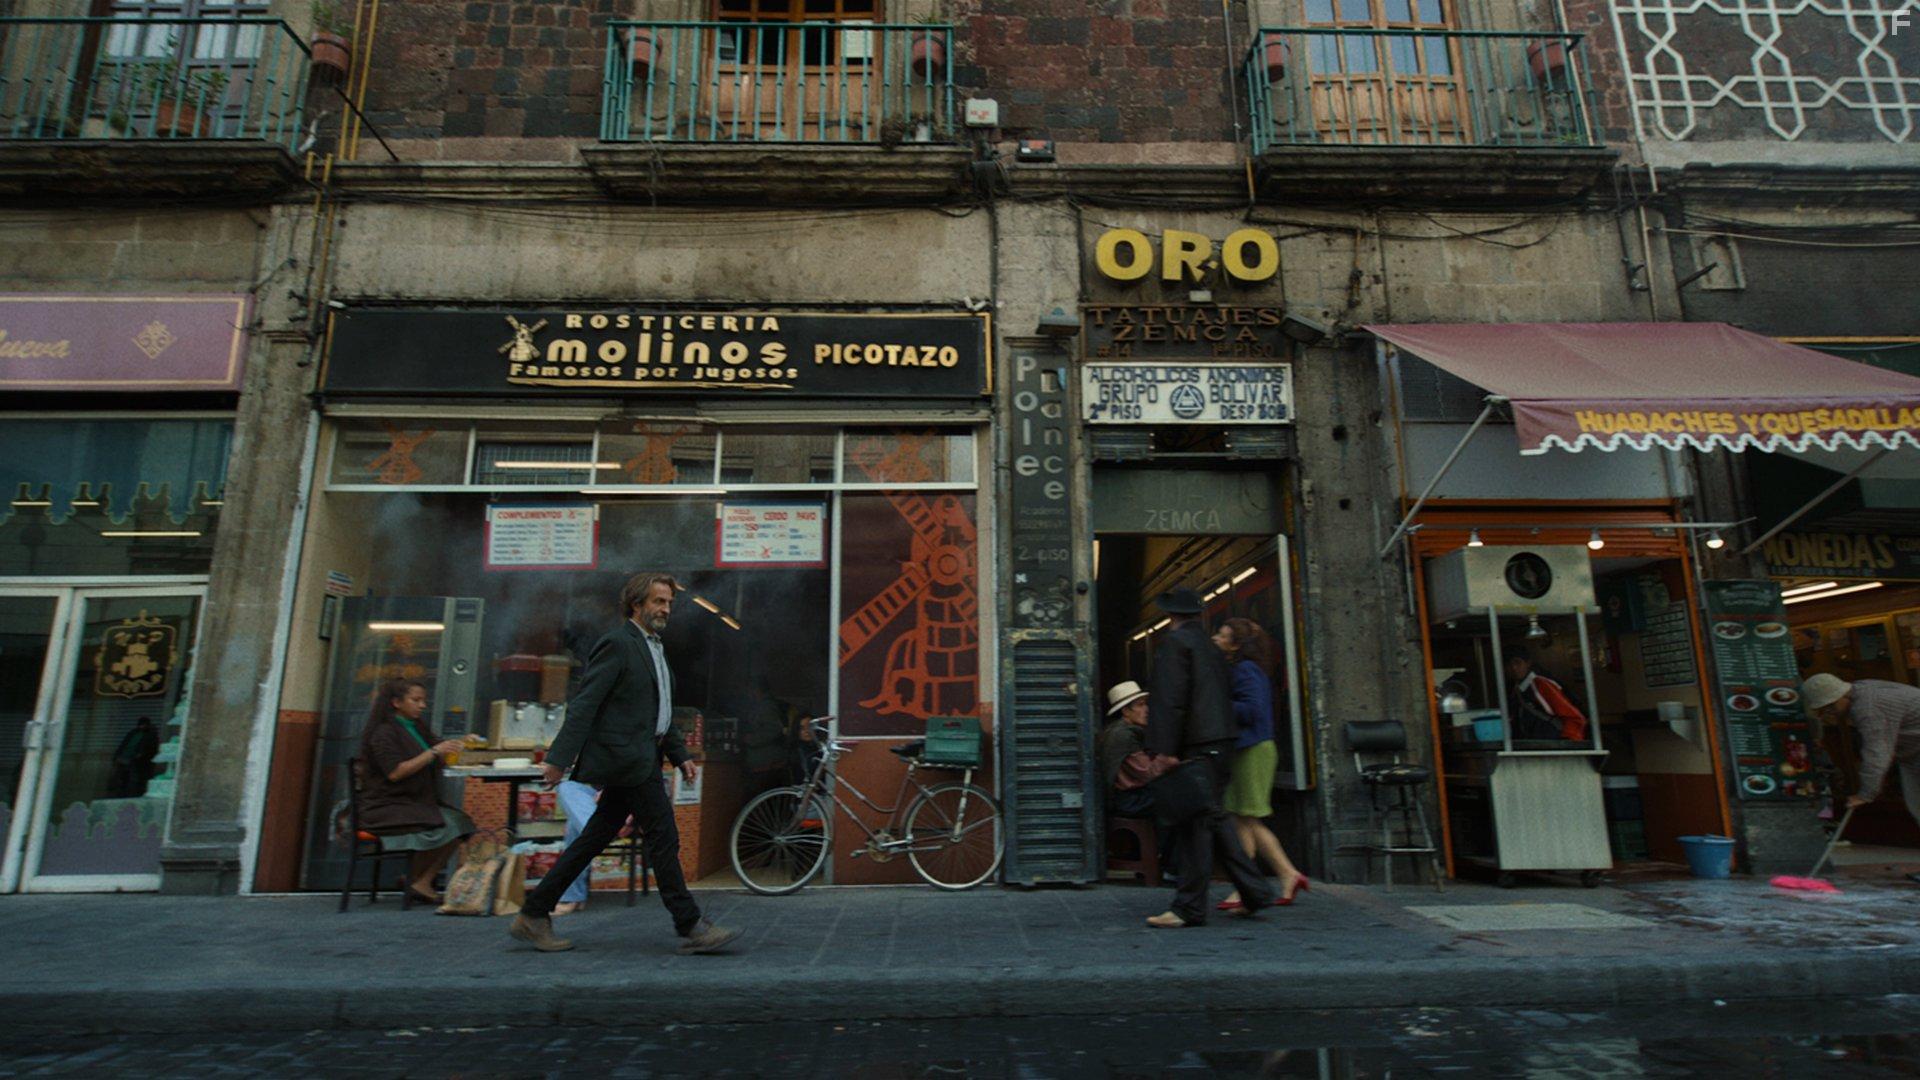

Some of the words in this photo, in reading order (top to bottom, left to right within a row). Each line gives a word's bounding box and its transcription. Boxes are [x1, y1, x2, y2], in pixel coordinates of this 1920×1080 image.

[1095, 228, 1280, 281] ORO
[565, 314, 779, 332] ROSTICERIA
[1088, 307, 1281, 326] TATUAJES
[1112, 325, 1258, 342] ZEMCA
[546, 332, 789, 365] molinos
[814, 344, 959, 368] PICOTAZO
[510, 362, 622, 377] Famosos
[634, 367, 679, 381] por
[1089, 367, 1200, 384] ALCOHOLICOS
[1099, 384, 1159, 404] GRUPO
[1209, 384, 1283, 404] BOLIVAR
[1110, 404, 1143, 420] PISO
[1575, 410, 1735, 434] HUARACHES
[1143, 509, 1222, 531] ZEMCA
